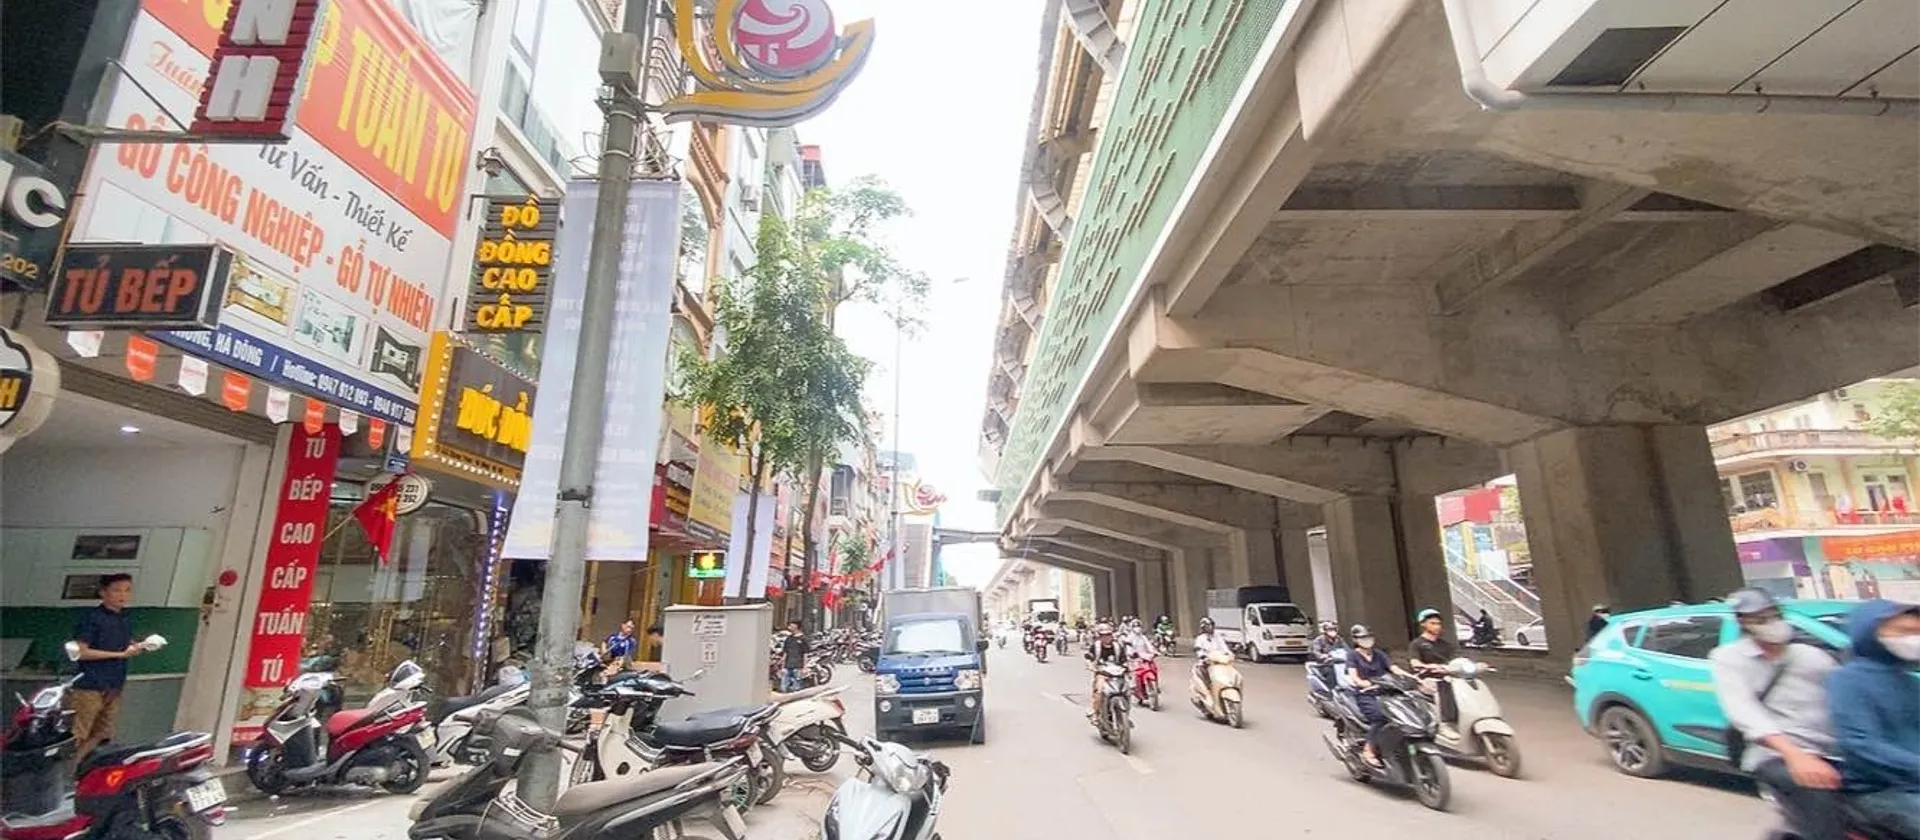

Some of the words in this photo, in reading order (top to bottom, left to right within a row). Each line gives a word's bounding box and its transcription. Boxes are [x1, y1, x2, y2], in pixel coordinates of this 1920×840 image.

[289, 150, 329, 200] Vấn
[344, 190, 385, 237] Thiết
[386, 221, 413, 252] Kế
[501, 193, 541, 228] ĐỒ
[165, 142, 242, 226] CÔNG
[242, 187, 324, 273] NGHIỆP
[336, 238, 367, 293] GỖ
[364, 260, 391, 315] TỰ
[387, 274, 434, 333] NHIÊN
[479, 228, 551, 265] ĐỒNG
[58, 253, 113, 314] TỦ
[114, 253, 197, 314] BẾP
[482, 267, 538, 291] CAO
[476, 293, 534, 328] CẤP
[305, 430, 326, 459] TỦ
[289, 473, 323, 501] BẾP
[280, 522, 315, 545] CAO
[270, 559, 307, 590] CẤP
[257, 604, 306, 636] TUẤN
[261, 654, 283, 684] TÚ
